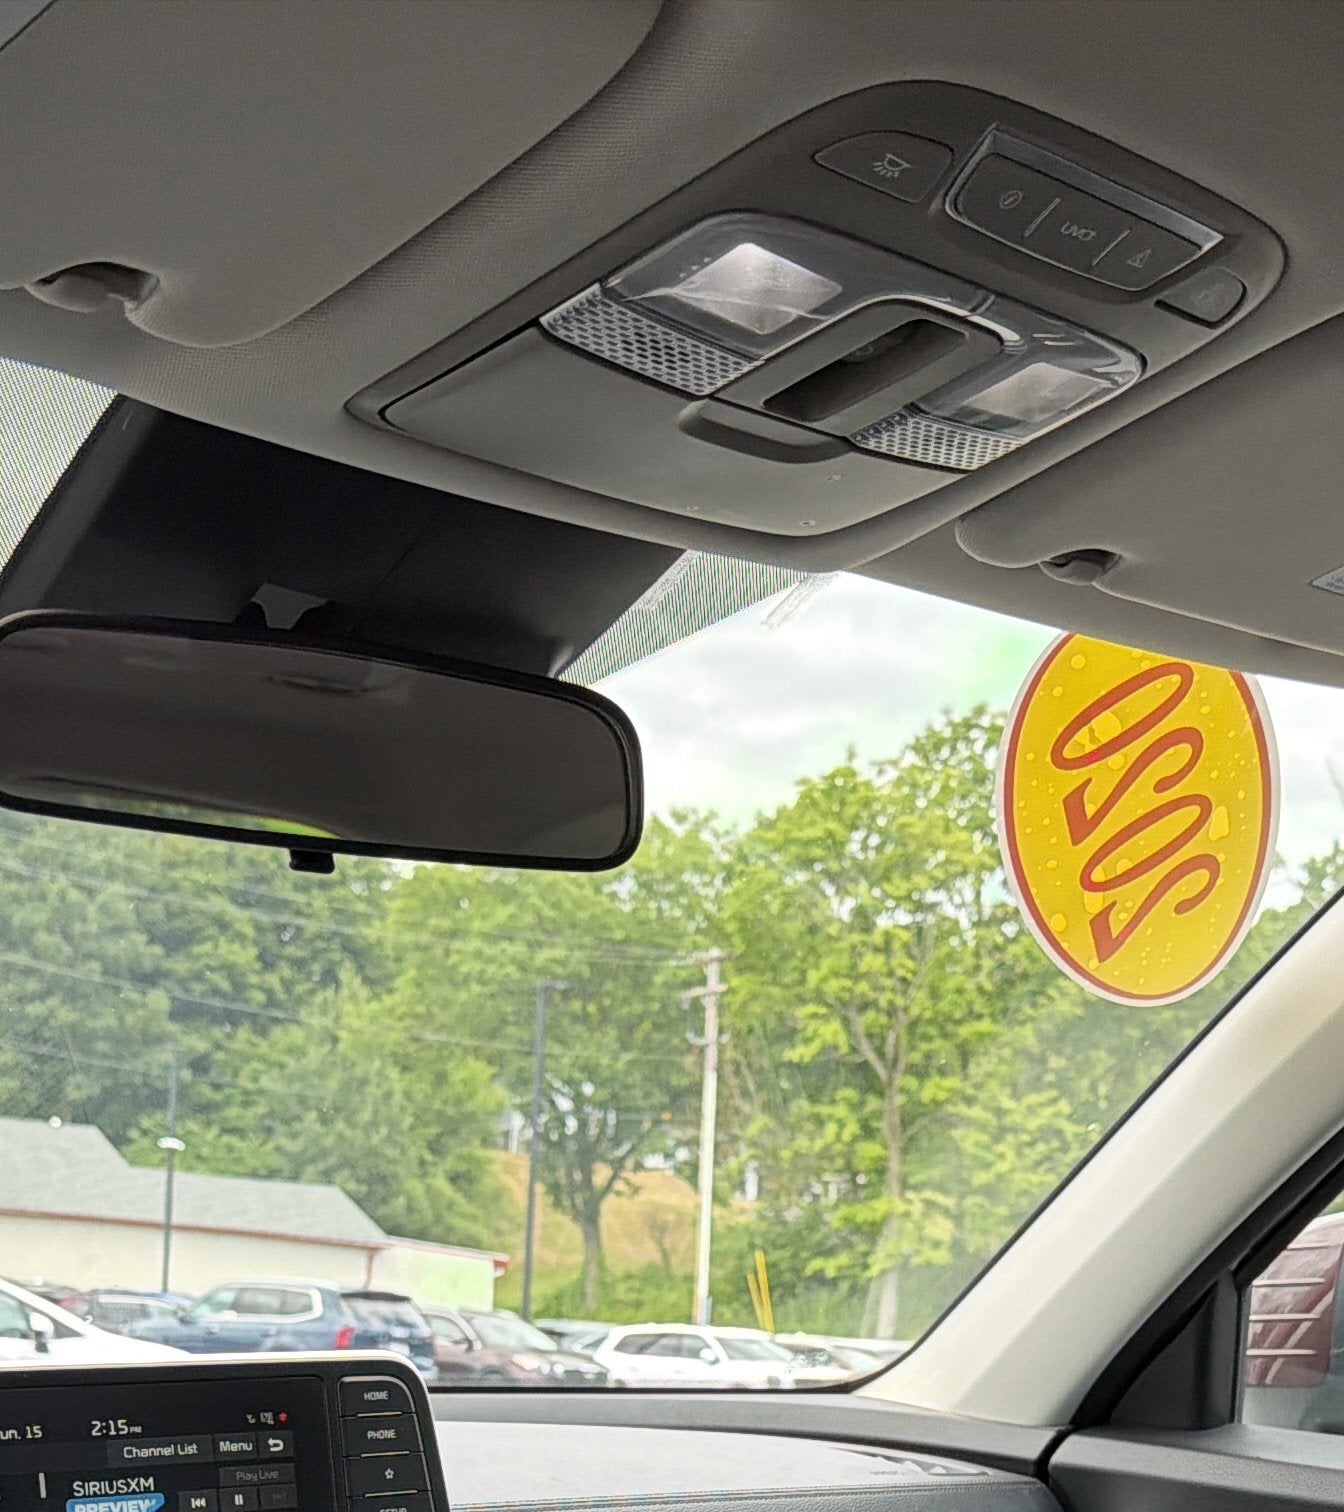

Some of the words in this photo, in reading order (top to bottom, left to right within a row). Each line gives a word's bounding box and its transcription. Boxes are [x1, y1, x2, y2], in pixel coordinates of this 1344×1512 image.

[363, 1390, 389, 1401] HOME
[25, 1425, 43, 1439] 15
[91, 1419, 129, 1437] 2:15
[367, 1429, 397, 1440] PHONE
[123, 1444, 175, 1459] Channel
[177, 1442, 198, 1456] List
[219, 1440, 253, 1452] Menu
[236, 1470, 258, 1482] Play
[259, 1469, 279, 1480] Live
[72, 1476, 155, 1497] SIRIUSXM
